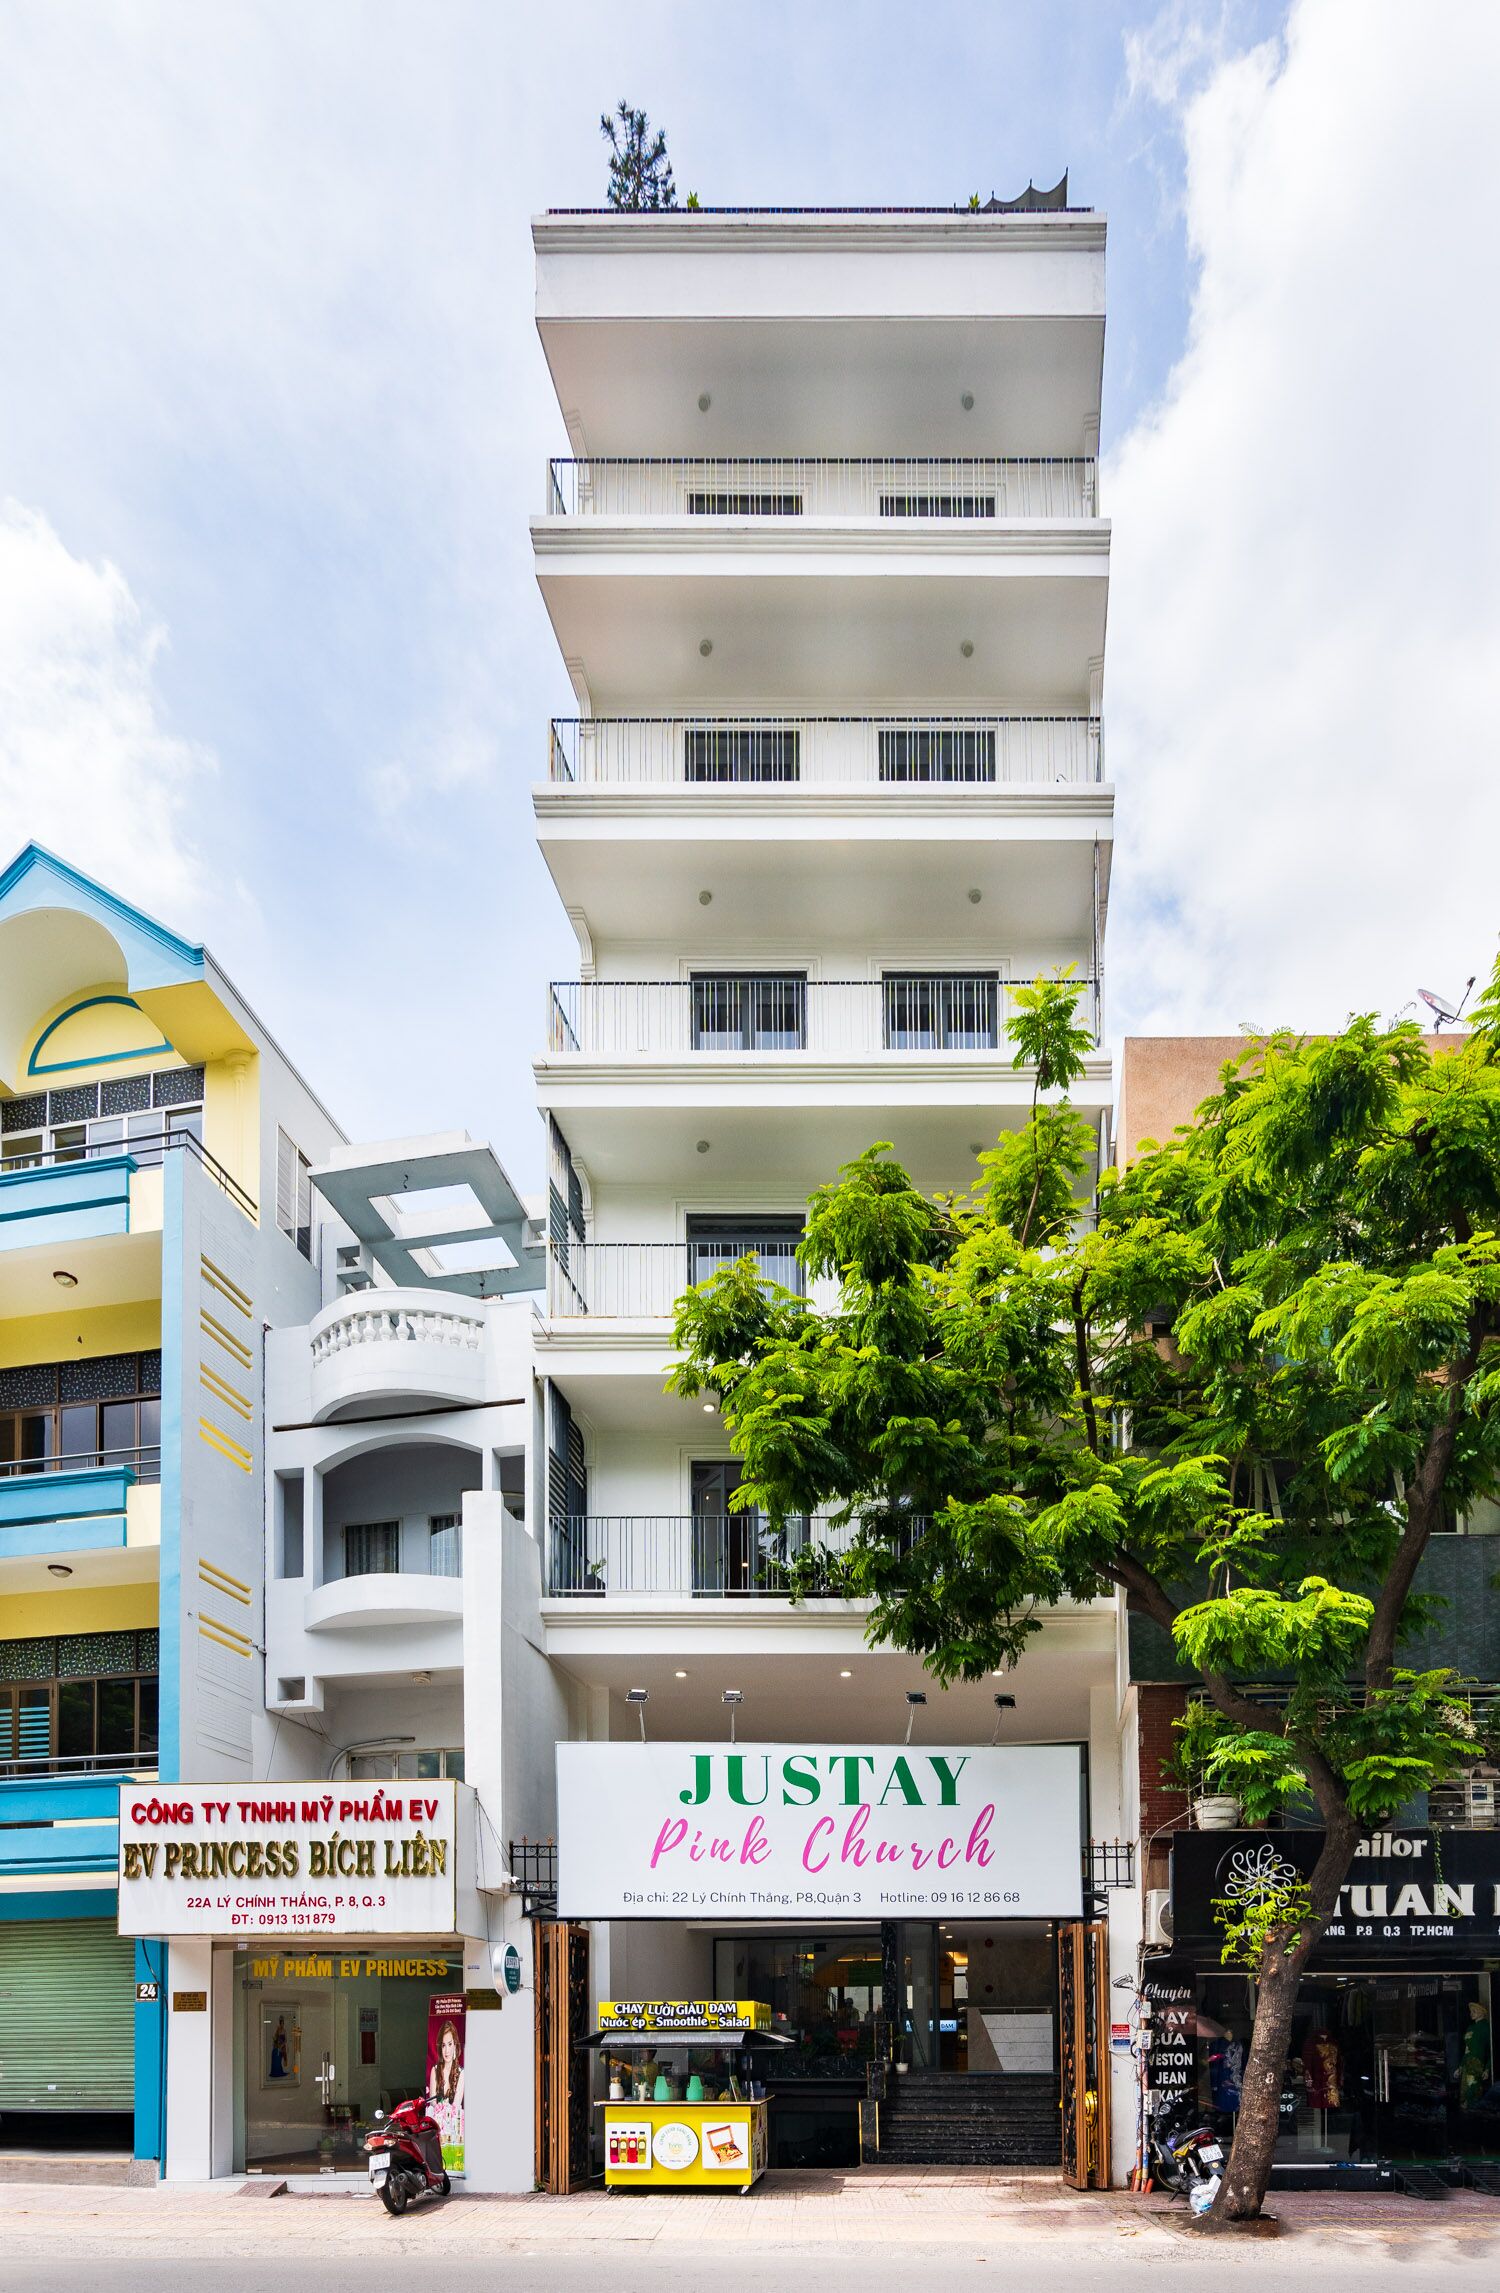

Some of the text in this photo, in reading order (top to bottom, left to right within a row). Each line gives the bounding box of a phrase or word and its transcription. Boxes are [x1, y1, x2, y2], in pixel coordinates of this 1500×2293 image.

[679, 1755, 971, 1806] JUSTAY
[131, 1789, 438, 1824] CÔNG TY TNHH MỸ PHẨM EV
[650, 1804, 996, 1874] Pink Church
[1354, 1832, 1427, 1858] ailor
[123, 1830, 448, 1880] EV PRINCESS BÍCH LIÊN
[187, 1897, 212, 1908] 22A
[217, 1894, 232, 1908] LÝ
[236, 1894, 276, 1908] CHÍNH
[280, 1892, 331, 1909] THẮNG,
[623, 1892, 644, 1904] Địa
[672, 1892, 688, 1902] 22
[692, 1892, 706, 1904] Lý
[710, 1892, 746, 1902] Chính
[853, 1892, 862, 1902] 3
[880, 1892, 928, 1902] Hotline:
[931, 1892, 947, 1902] 09
[951, 1892, 964, 1902] 16
[1004, 1892, 1020, 1902] 68
[232, 1914, 254, 1925] ĐT:
[258, 1914, 288, 1925] 0913
[1356, 1926, 1372, 1936] P.8
[1383, 1926, 1400, 1936] Q.3
[1410, 1926, 1454, 1936] TP.HCM
[253, 1954, 448, 1977] MỸ PHẨM EV PRINCESS
[140, 1984, 156, 1998] 24
[614, 2002, 736, 2016] CHAY LƯỜI GIÀU ĐẠM
[600, 2017, 629, 2027] Nước
[632, 2017, 646, 2029] ép
[656, 2016, 708, 2027] Smoothie
[719, 2016, 750, 2027] Salad
[1156, 2071, 1187, 2084] JEAN
